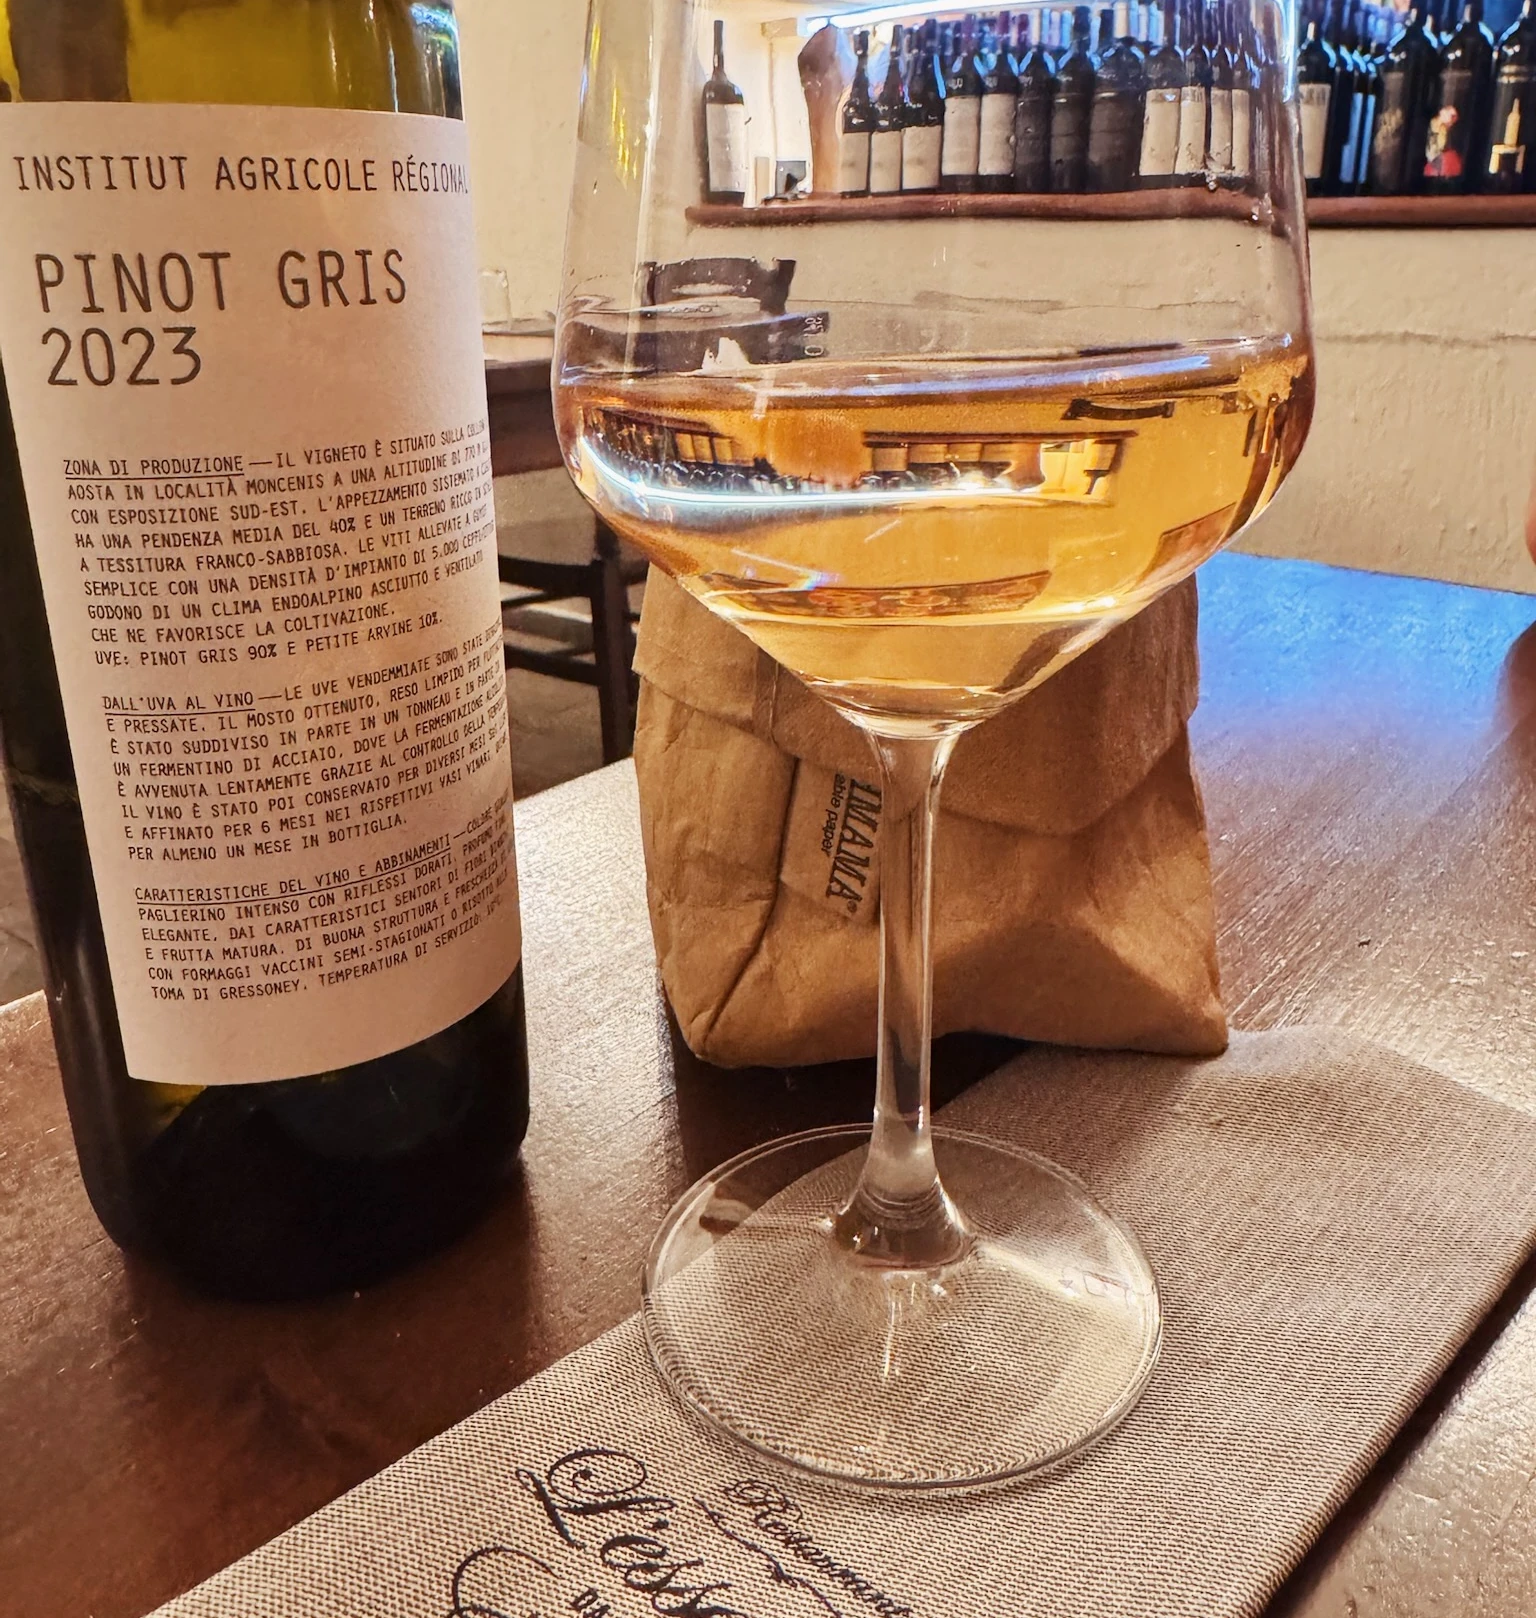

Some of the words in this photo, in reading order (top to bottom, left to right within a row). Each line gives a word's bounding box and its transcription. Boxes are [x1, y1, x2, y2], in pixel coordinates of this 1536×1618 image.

[13, 156, 188, 191] INSTITUT
[215, 157, 378, 191] AGRICOLE
[35, 252, 231, 313] PINOT
[278, 249, 406, 309] GRIS
[41, 326, 202, 386] 2023
[64, 460, 101, 474] ZONA
[109, 460, 129, 474] DI
[304, 445, 366, 464] VIGNETO
[375, 440, 381, 457] È
[391, 434, 435, 454] SITUATO
[69, 485, 114, 500] AOSTA
[125, 485, 144, 500] IN
[155, 479, 237, 500] LOCALITÀ
[246, 474, 323, 495] MONCENIS
[334, 472, 343, 486] A
[351, 468, 376, 484] UNA
[384, 454, 446, 480] ALTITUDINE
[72, 509, 98, 524] CON
[108, 507, 219, 525] ESPOSIZIONE
[75, 533, 94, 548] HA
[102, 534, 132, 549] UNA
[141, 531, 223, 548] PENDENZA
[233, 526, 283, 544] MEDIA
[292, 522, 320, 539] DEL
[330, 517, 355, 533] 40%
[364, 515, 372, 529] E
[380, 511, 395, 526] UN
[81, 558, 89, 571] A
[97, 557, 186, 573] TESSITURA
[196, 543, 347, 570] FRANCO-SABBIOSA.
[359, 538, 374, 553] LE
[382, 530, 410, 547] VITI
[84, 581, 158, 596] SEMPLICE
[168, 580, 198, 595] CON
[208, 577, 239, 593] UNA
[248, 567, 316, 591] DENSITÀ
[326, 554, 406, 581] D'IMPIANTO
[88, 605, 142, 620] GODONO
[153, 605, 170, 620] DI
[182, 604, 201, 618] UN
[212, 600, 261, 616] CLIMA
[272, 586, 362, 611] ENDOALPINO
[371, 570, 428, 597] ASCIUTTO
[92, 628, 118, 642] CHE
[127, 629, 146, 642] NE
[156, 624, 245, 642] FAVORISCE
[256, 621, 275, 636] LA
[284, 602, 394, 632] COLTIVAZIONE.
[95, 651, 128, 666] UVE:
[140, 651, 186, 665] PINOT
[198, 648, 238, 663] GRIS
[248, 644, 277, 660] 90%
[288, 642, 296, 655] E
[306, 631, 358, 652] PETITE
[368, 619, 412, 641] ARVINE
[186, 696, 206, 710] AL
[312, 680, 338, 696] UVE
[347, 657, 430, 689] VENDEMMIATE
[218, 716, 237, 730] IL
[247, 709, 294, 728] MOSTO
[304, 695, 379, 720] OTTENUTO,
[390, 682, 418, 702] RESO
[111, 738, 119, 754] È
[128, 741, 172, 755] STATO
[182, 735, 268, 754] SUDDIVISO
[280, 731, 296, 745] IN
[307, 721, 351, 741] PARTE
[361, 715, 375, 730] IN
[384, 709, 398, 725] UN
[114, 762, 130, 776] UN
[140, 760, 232, 776] FERMENTINO
[243, 757, 261, 772] DI
[272, 746, 342, 768] ACCIAIO,
[353, 734, 386, 754] DOVE
[394, 728, 408, 745] LA
[118, 781, 126, 797] È
[135, 783, 208, 798] AVVENUTA
[218, 772, 311, 795] LENTAMENTE
[321, 759, 372, 781] GRAZIE
[380, 754, 396, 768] AL
[122, 805, 138, 818] IL
[146, 806, 182, 819] VINO
[192, 803, 201, 818] È
[211, 801, 258, 818] STATO
[269, 796, 294, 811] POI
[305, 776, 390, 806] CONSERVATO
[398, 766, 419, 784] PER
[142, 826, 213, 840] AFFINATO
[224, 823, 252, 837] PER
[261, 821, 270, 833] 6
[280, 814, 315, 831] MESI
[326, 807, 350, 823] NEI
[361, 781, 432, 816] RISPETTIVI
[821, 808, 839, 858] paper
[128, 847, 153, 860] PER
[163, 847, 216, 861] ALMENO
[227, 845, 244, 858] UN
[255, 839, 291, 855] MESE
[302, 834, 319, 849] IN
[329, 814, 406, 843] BOTTIGLIA.
[135, 883, 269, 901] CARATTERISTICHE
[280, 879, 306, 894] DEL
[315, 869, 349, 887] VINO
[359, 865, 366, 877] E
[139, 908, 225, 922] PAGLIERINO
[236, 900, 299, 919] INTENSO
[308, 893, 334, 908] CON
[344, 873, 406, 902] RIFLESSI
[142, 928, 216, 941] ELEGANTE,
[229, 926, 255, 940] DAI
[266, 899, 385, 936] CARATTERISTICI
[395, 877, 441, 906] SENTORI
[162, 949, 214, 961] FRUTTA
[296, 937, 312, 951] DI
[323, 926, 365, 946] BUONA
[374, 899, 438, 933] STRUTTURA
[149, 967, 172, 980] CON
[182, 966, 250, 981] FORMAGGI
[261, 955, 323, 975] VACCINI
[152, 987, 184, 1000] TOMA
[193, 988, 208, 1000] DI
[319, 951, 408, 986] TEMPERATURA
